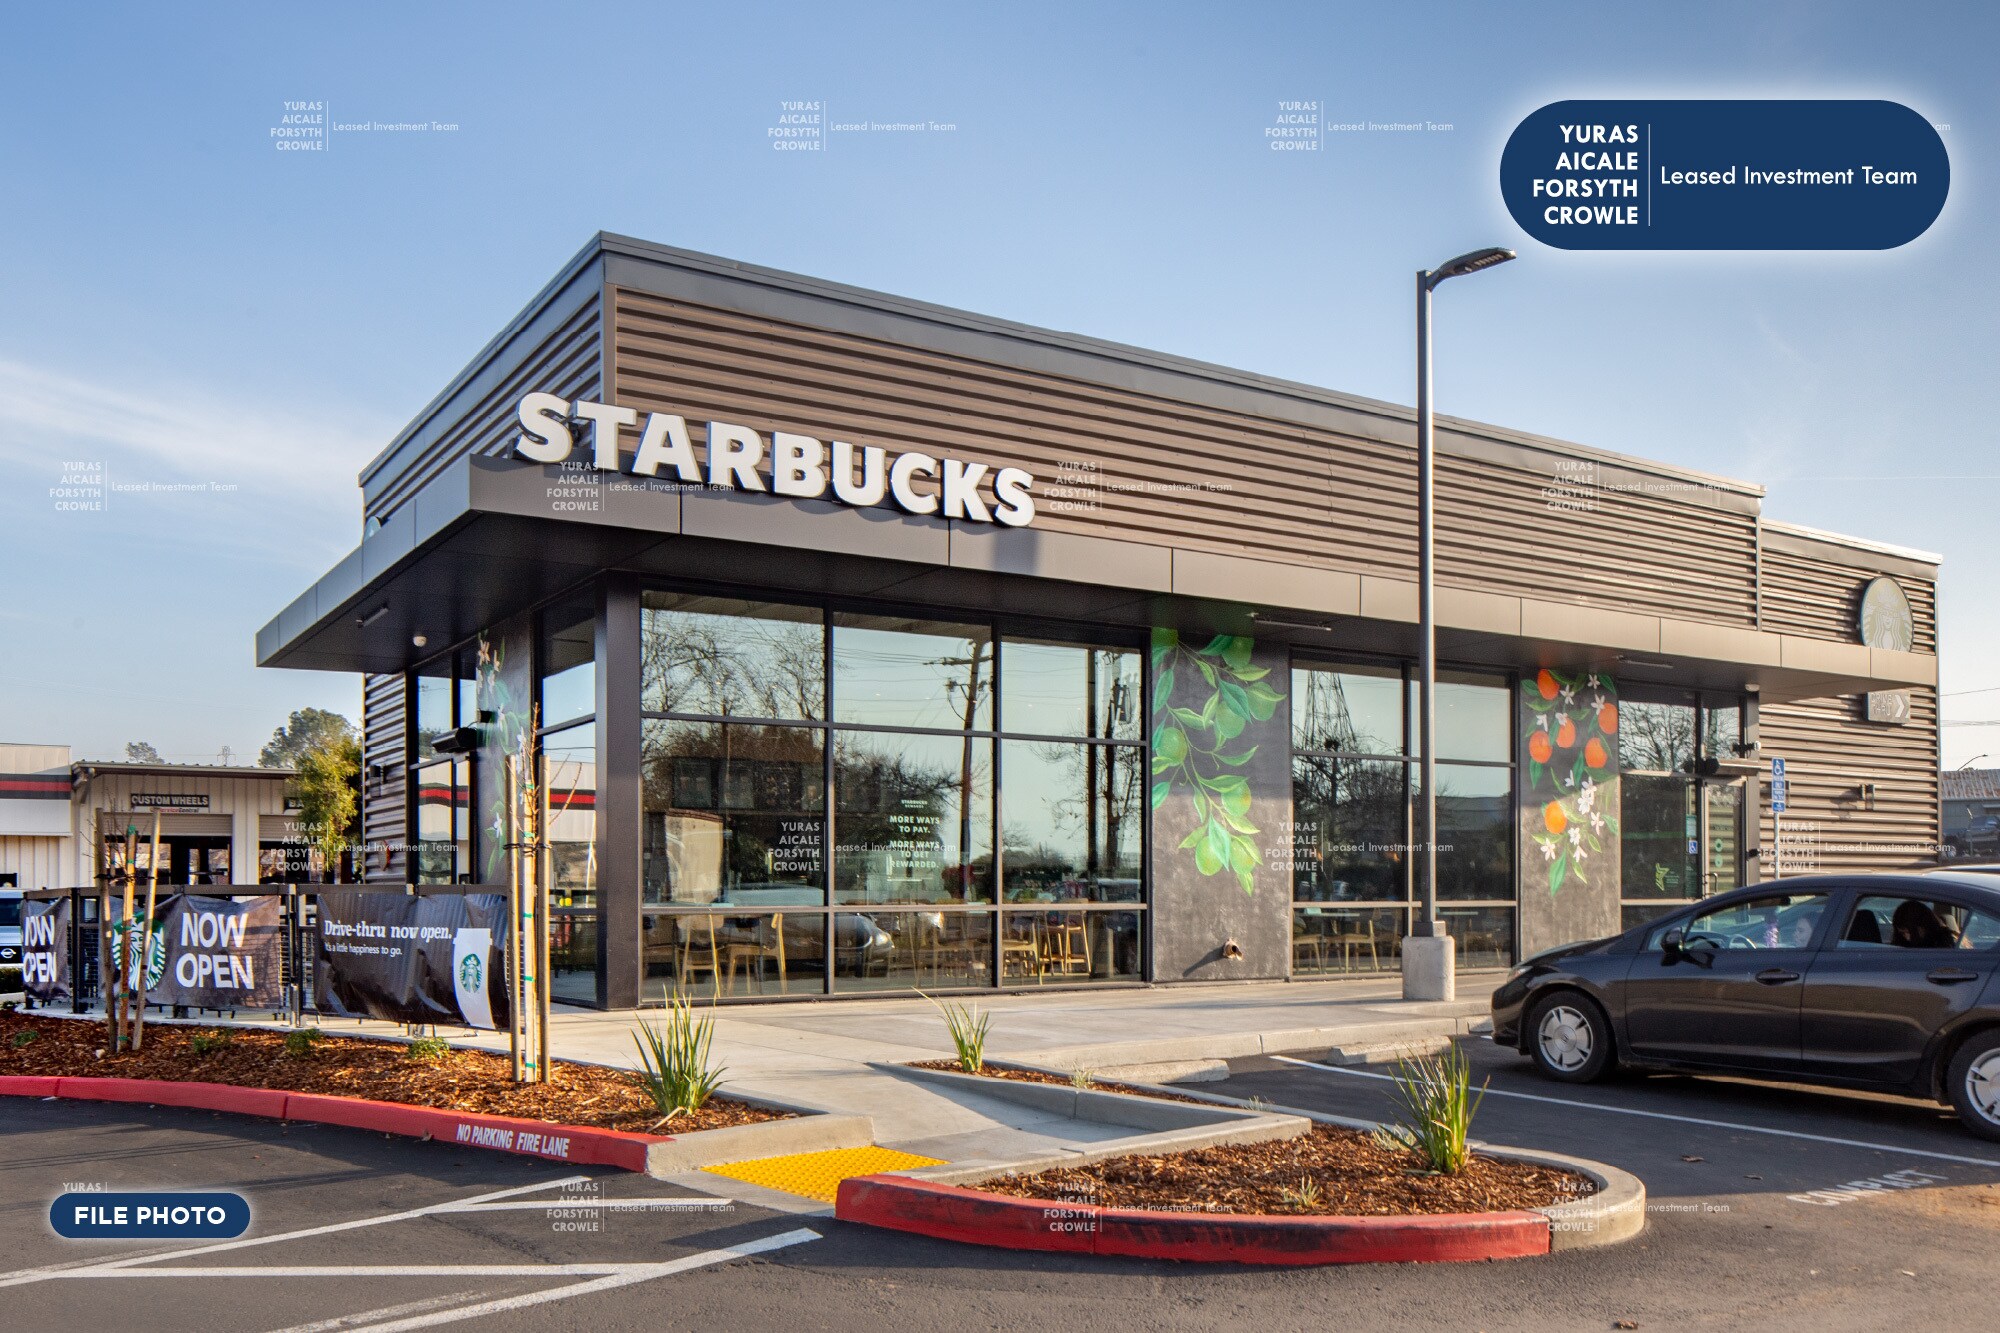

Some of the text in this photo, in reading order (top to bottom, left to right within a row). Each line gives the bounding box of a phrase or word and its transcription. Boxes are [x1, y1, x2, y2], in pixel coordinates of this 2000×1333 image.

[514, 392, 1036, 527] STARBUCKS
[132, 795, 208, 806] CUSTOM WHEELS
[889, 815, 940, 824] MORE WAYS
[899, 825, 931, 834] TO PAY.
[889, 840, 940, 849] MORE WAYS
[181, 912, 249, 948] NOW
[324, 920, 386, 938] Drive-thru
[420, 926, 453, 943] open.
[349, 943, 380, 955] happiness
[381, 946, 389, 954] to
[390, 947, 403, 957] go.
[23, 951, 57, 983] OPEN
[175, 953, 255, 990] OPEN
[456, 1124, 570, 1157] NO PARKING FIRE LANE
